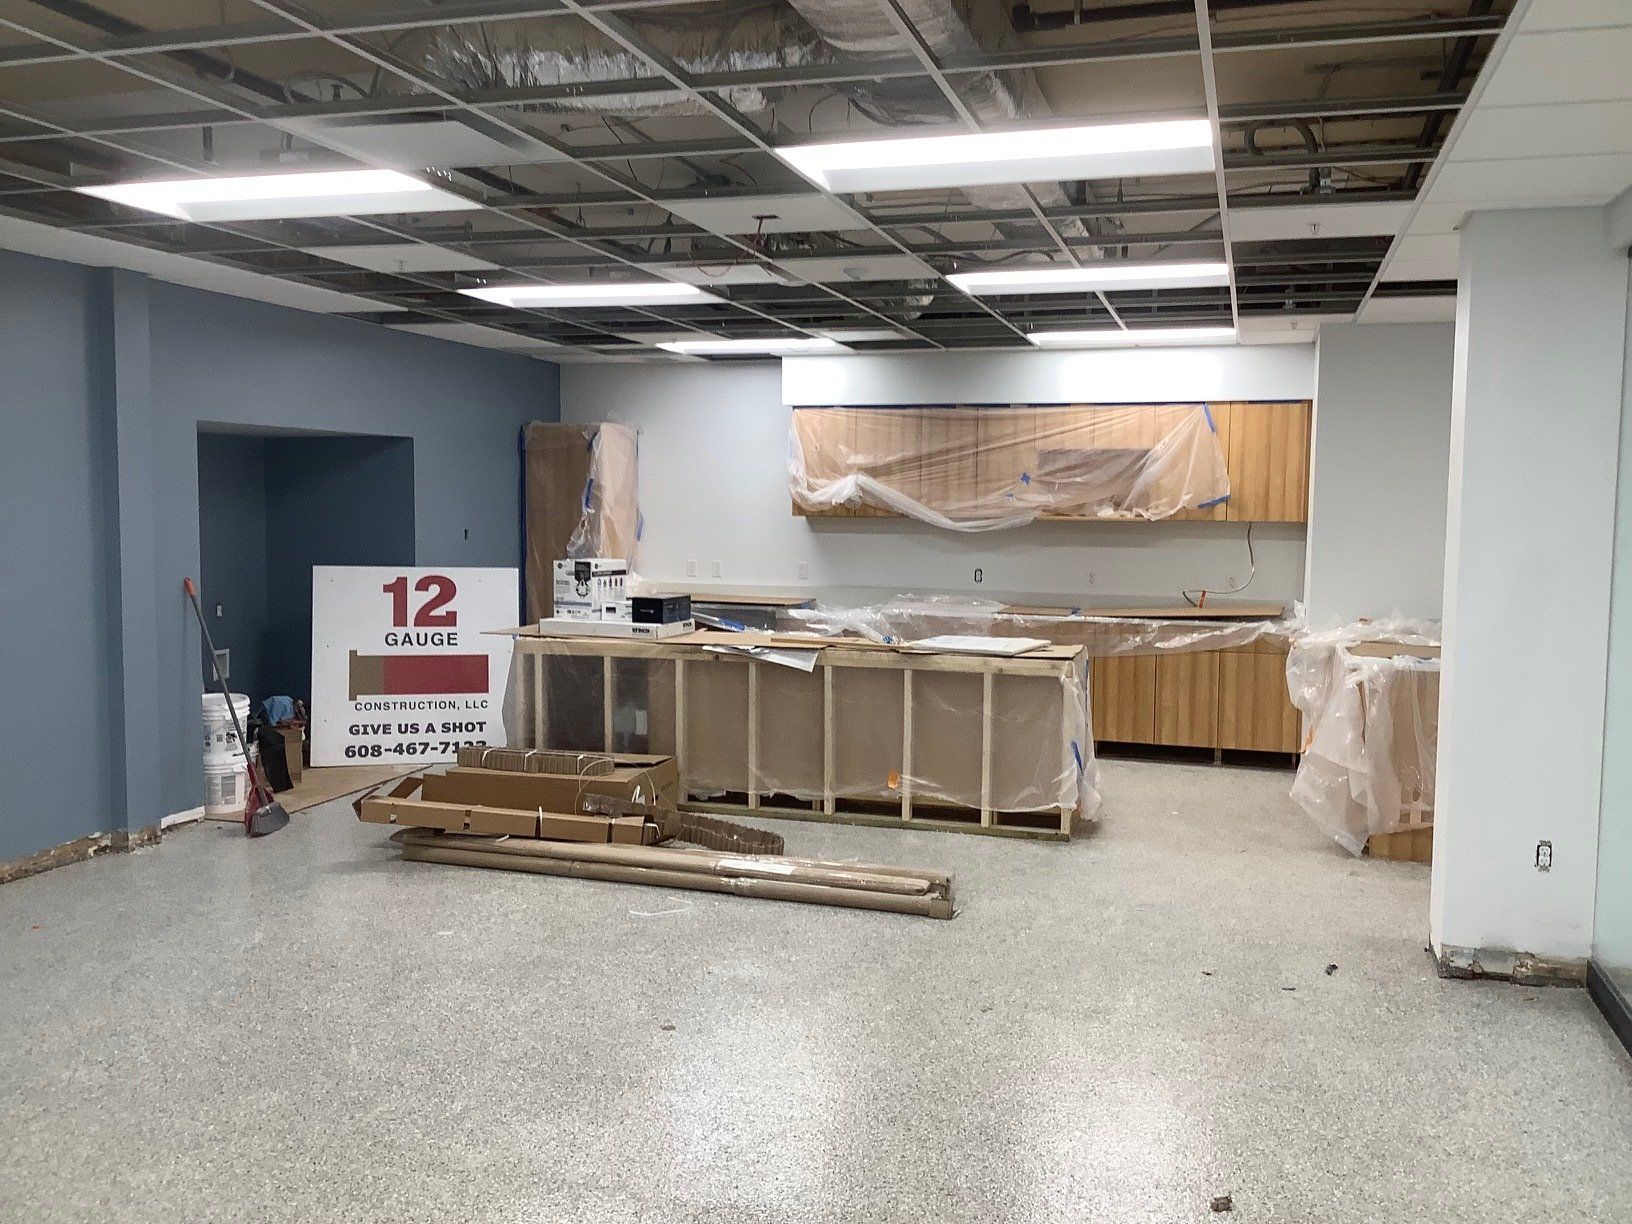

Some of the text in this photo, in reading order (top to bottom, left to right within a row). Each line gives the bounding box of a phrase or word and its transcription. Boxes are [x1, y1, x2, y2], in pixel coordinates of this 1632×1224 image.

[383, 575, 458, 627] 12
[384, 632, 458, 647] GAUGE
[354, 699, 488, 711] CONSTRUCTION, LLC
[349, 721, 487, 736] GIVE US A SHOT
